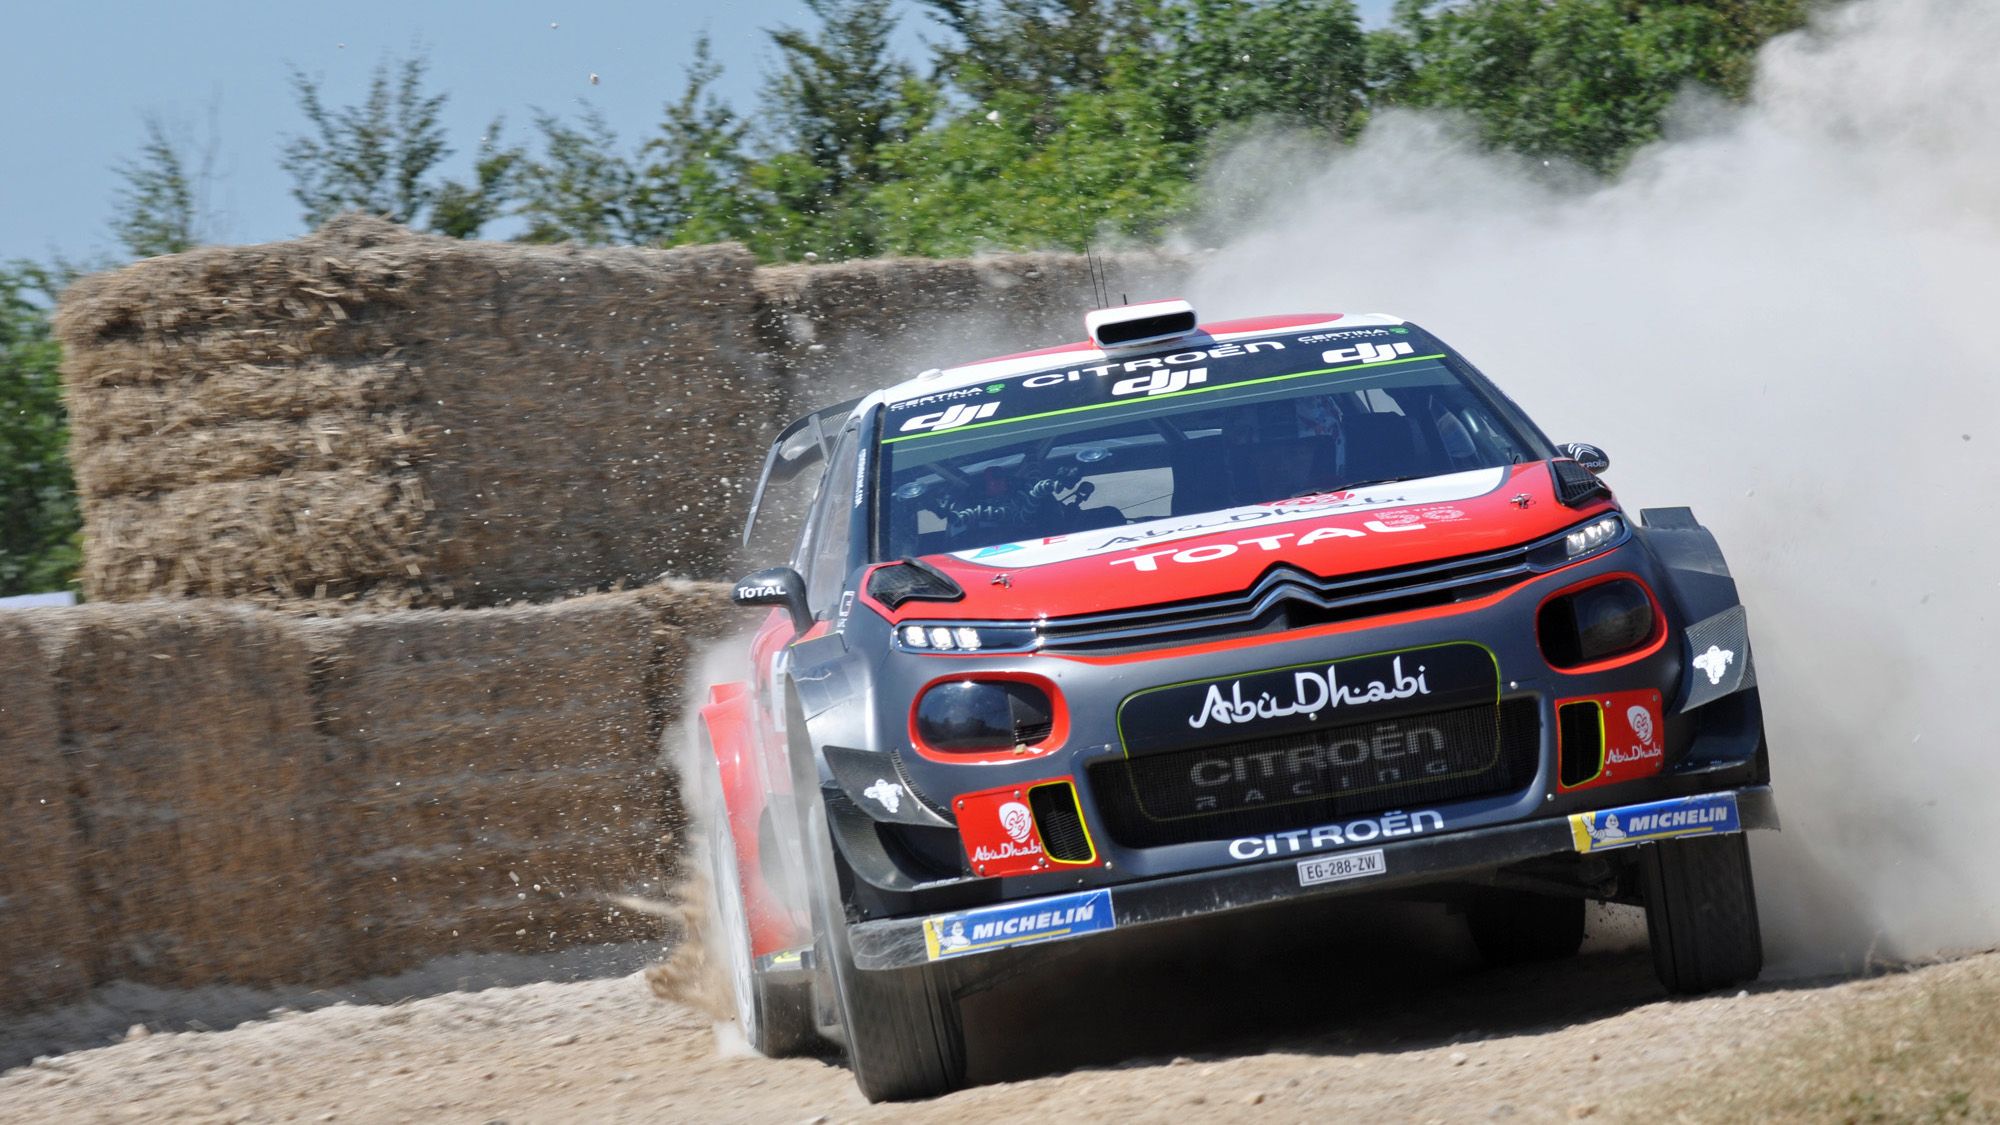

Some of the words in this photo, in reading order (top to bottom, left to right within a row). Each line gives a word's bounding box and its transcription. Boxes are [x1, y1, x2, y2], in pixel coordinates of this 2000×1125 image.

[1298, 329, 1389, 342] CERTINA
[1110, 520, 1426, 572] TOTAL
[738, 585, 787, 600] TOTAL
[1195, 759, 1448, 810] RACING
[1628, 806, 1728, 833] MICHELIN
[1306, 855, 1376, 880] EG-288-ZW
[972, 904, 1095, 940] MICHELIN
